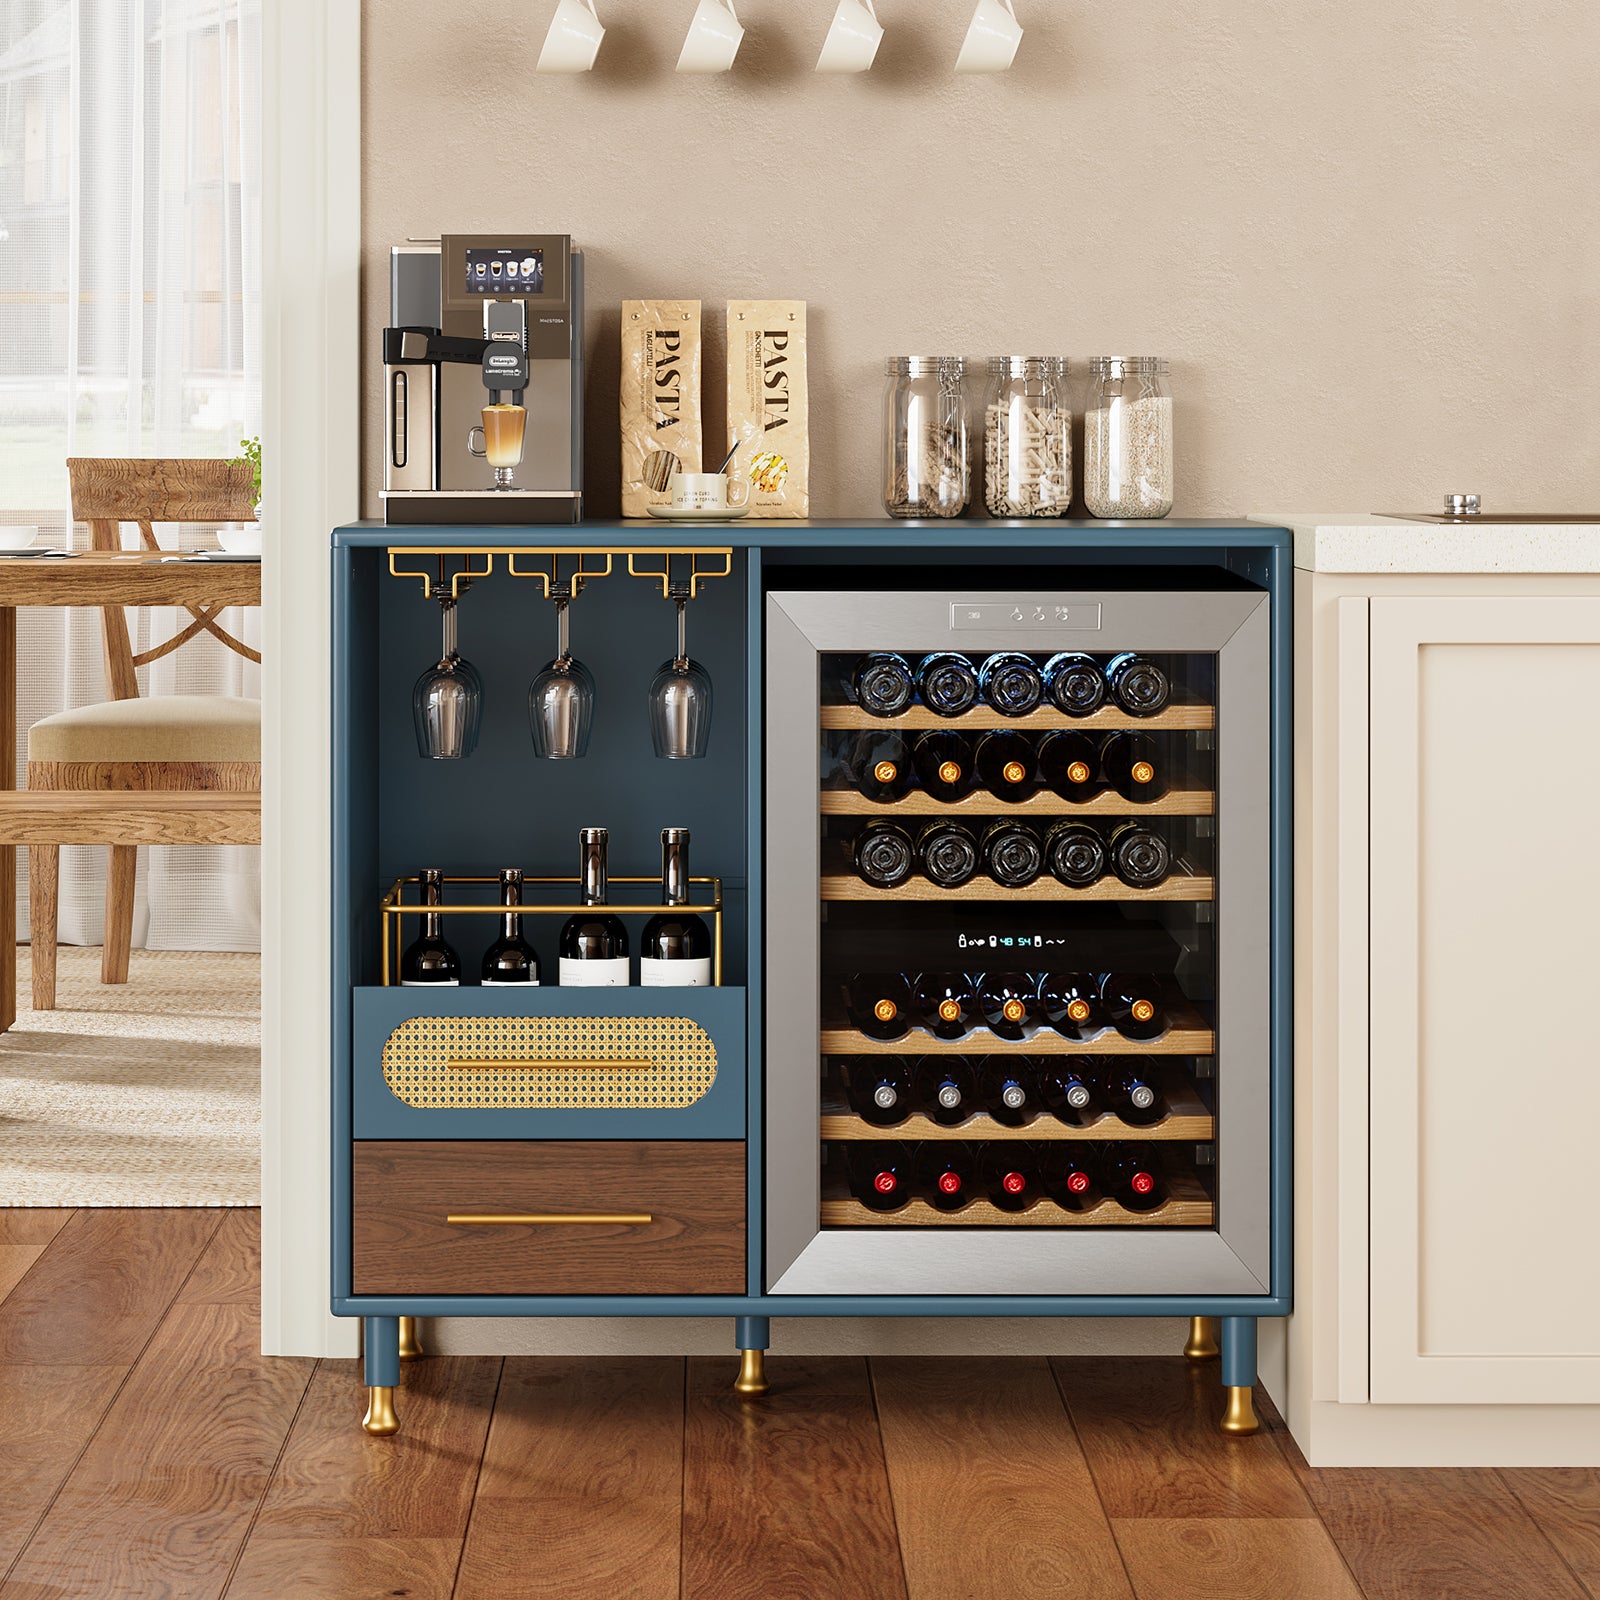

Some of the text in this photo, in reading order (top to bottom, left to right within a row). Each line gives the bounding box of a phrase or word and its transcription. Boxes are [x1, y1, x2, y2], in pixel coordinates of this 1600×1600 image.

[655, 330, 681, 432] PASTA
[764, 330, 789, 432] PASTA
[1018, 937, 1031, 946] 54
